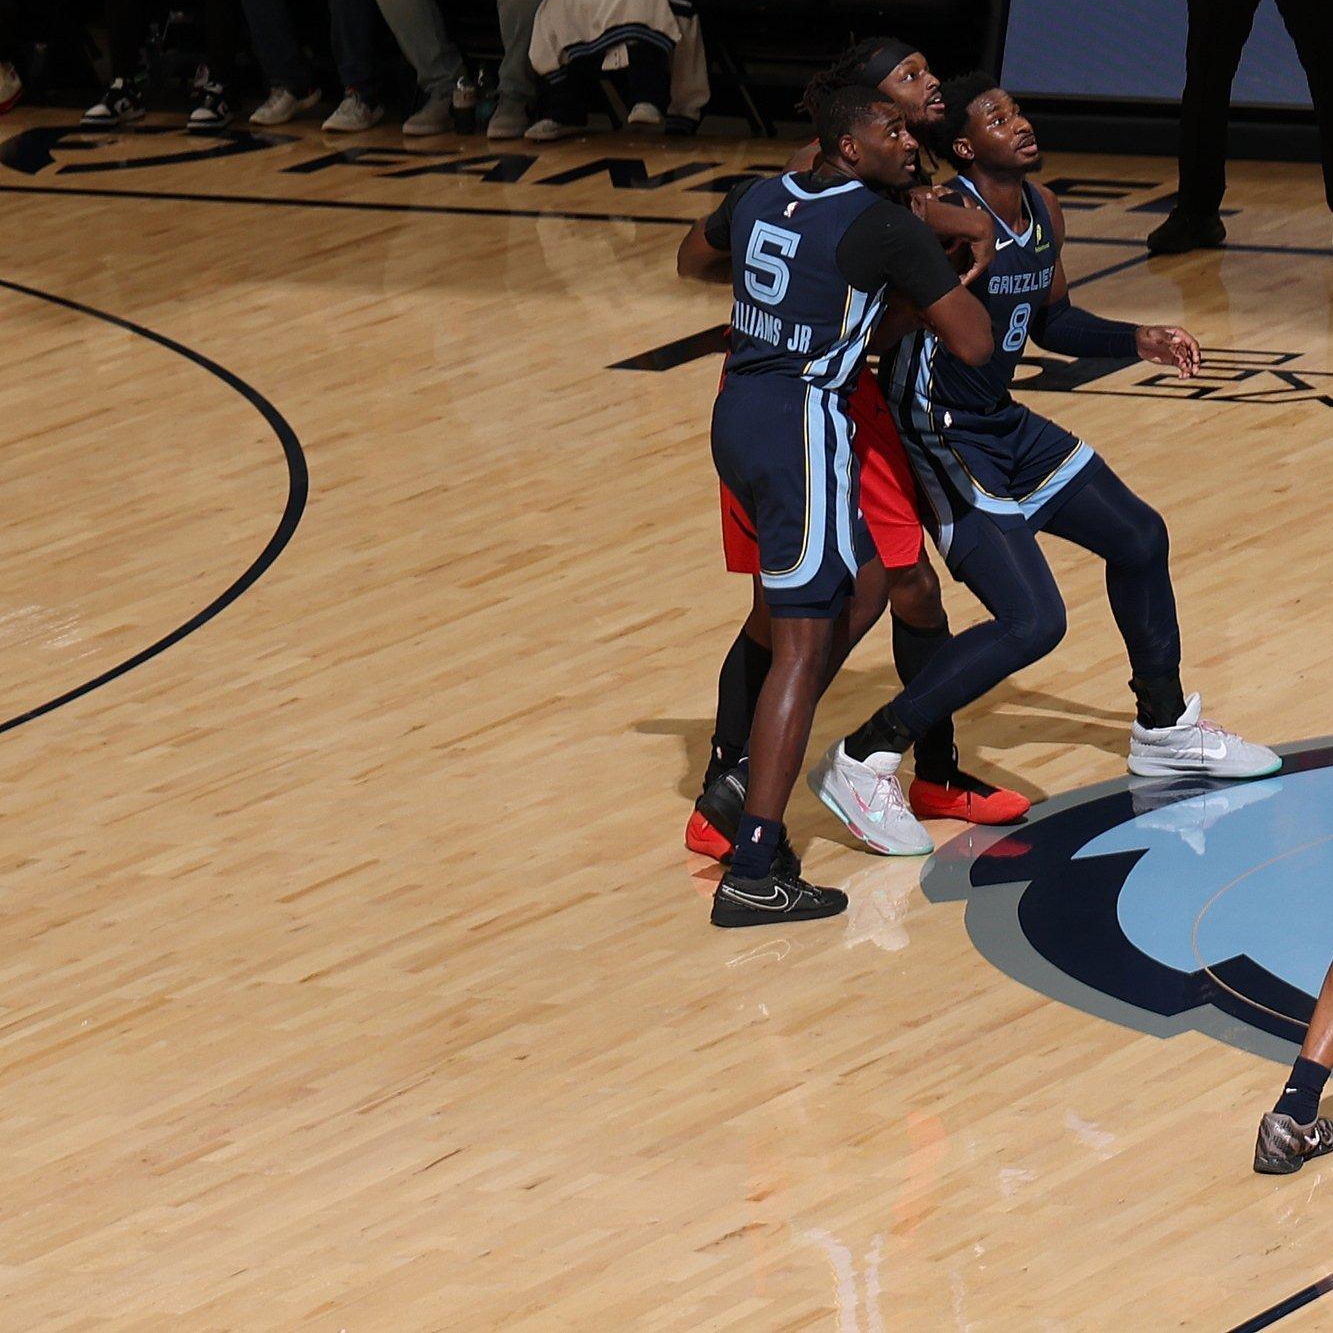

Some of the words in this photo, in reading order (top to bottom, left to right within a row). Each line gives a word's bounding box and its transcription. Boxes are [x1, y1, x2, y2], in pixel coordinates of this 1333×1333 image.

[744, 219, 801, 306] 5
[988, 265, 1055, 296] GRIZZLIE
[787, 330, 814, 355] JR
[1001, 301, 1033, 353] 8
